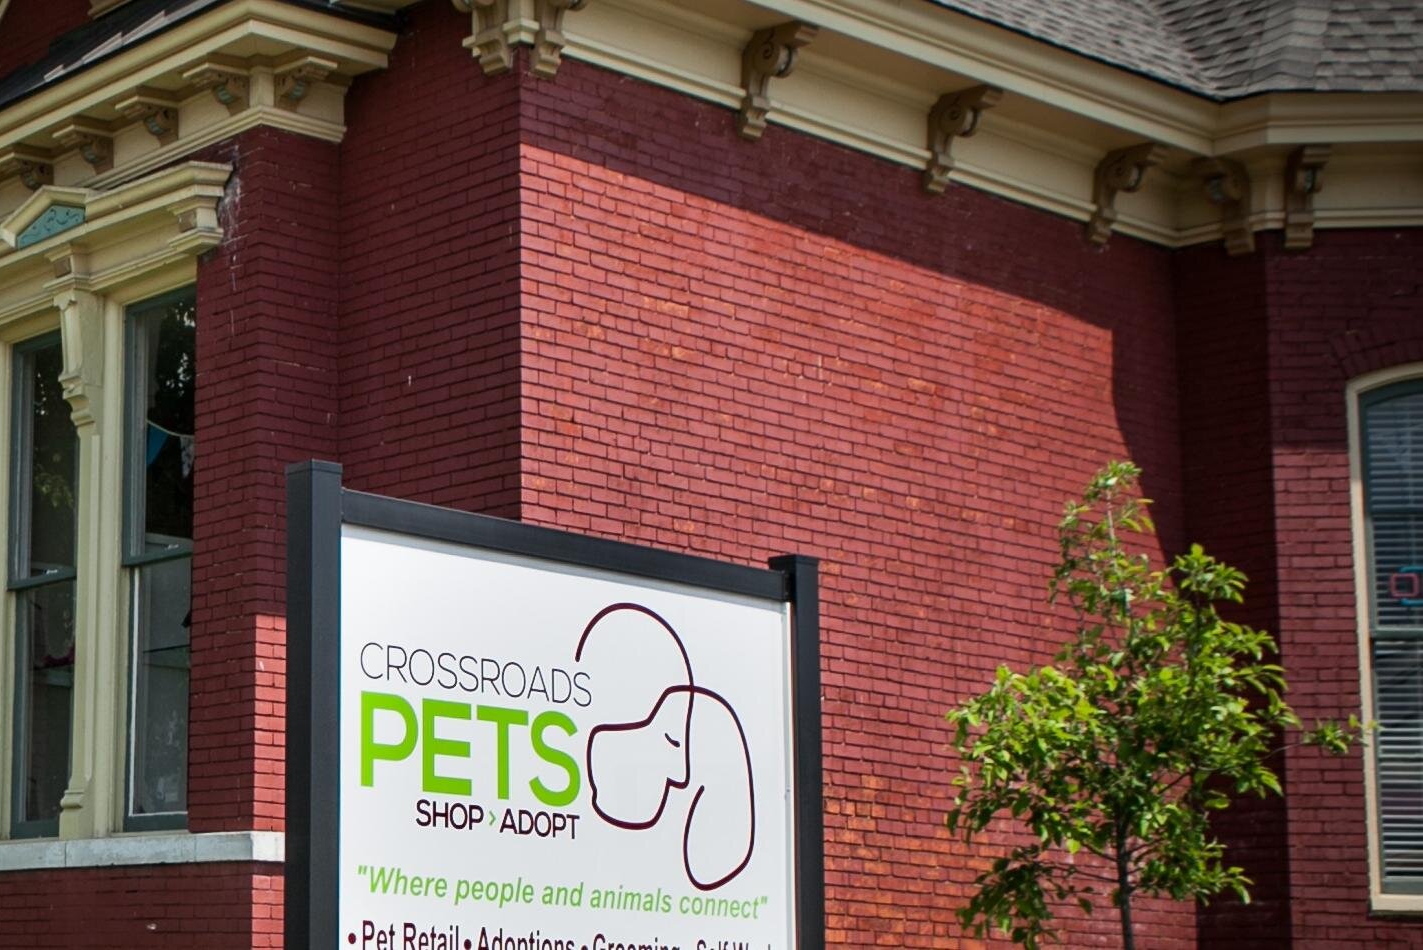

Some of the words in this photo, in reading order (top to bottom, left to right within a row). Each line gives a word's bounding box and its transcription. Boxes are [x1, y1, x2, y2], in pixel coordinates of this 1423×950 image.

[360, 642, 592, 707] CROSSROADS
[360, 690, 581, 807] PETS
[415, 799, 484, 831] SHOP
[499, 808, 580, 839] ADOPT
[357, 865, 448, 898] "Where
[453, 877, 534, 909] people
[541, 882, 584, 907] and
[589, 885, 673, 913] animals
[679, 895, 768, 919] connect"
[362, 920, 396, 950] Pet
[403, 922, 459, 950] Retail
